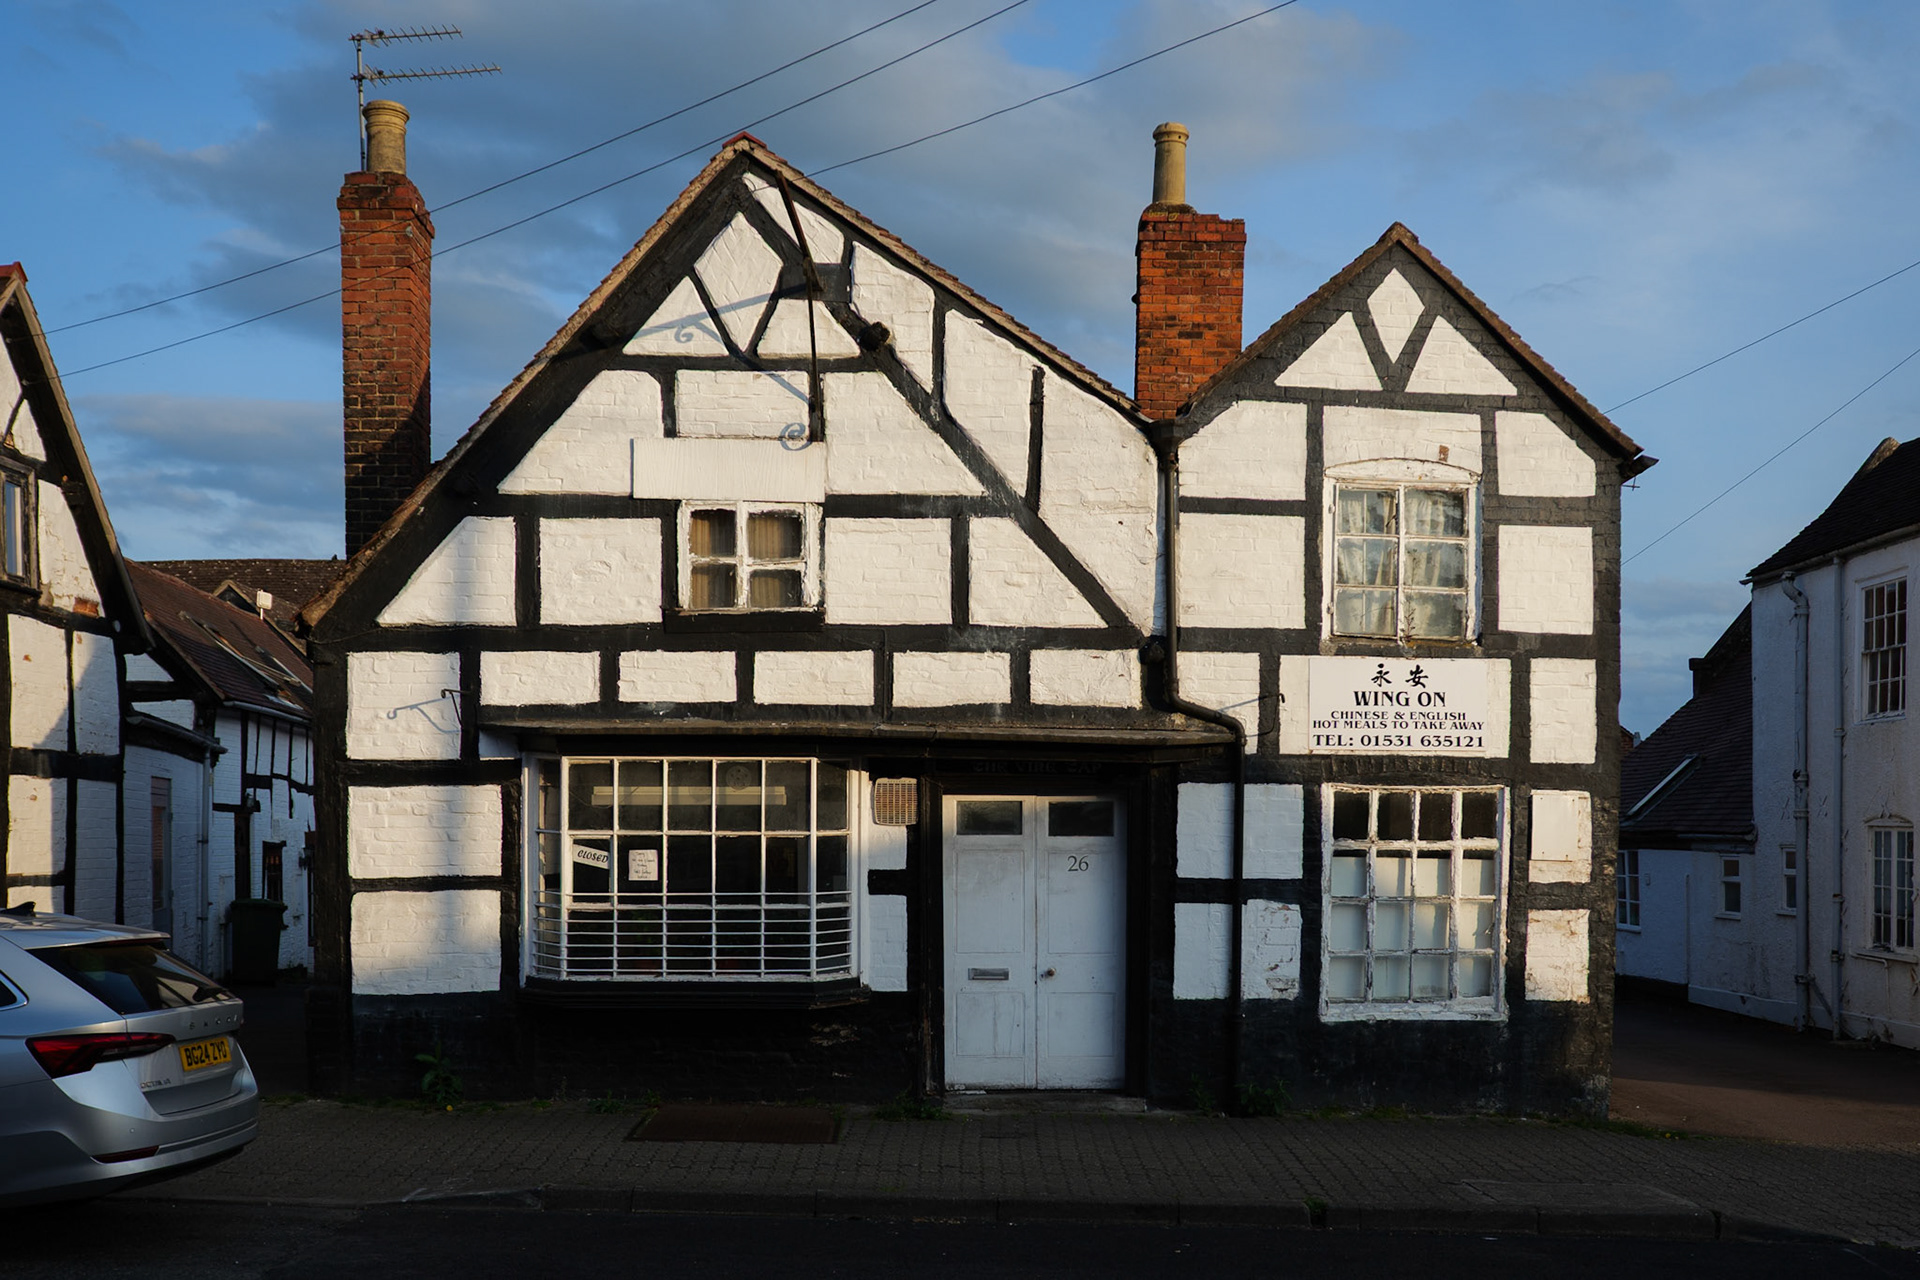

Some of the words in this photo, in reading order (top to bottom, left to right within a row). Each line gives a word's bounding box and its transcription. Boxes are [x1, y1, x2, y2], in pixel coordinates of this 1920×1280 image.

[1371, 663, 1429, 688] 永安
[1354, 691, 1410, 707] WING
[1417, 691, 1446, 707] ON
[1331, 711, 1389, 720] CHINESE
[1394, 711, 1405, 720] &
[1410, 712, 1467, 721] ENGLISH
[1313, 720, 1340, 729] HOT
[1344, 720, 1387, 729] MEALS
[1391, 720, 1409, 730] TO
[1413, 721, 1446, 730] TAKE
[1450, 721, 1484, 731] AWAY
[1313, 734, 1354, 747] TEL:
[1361, 735, 1413, 747] 01531
[1420, 735, 1484, 748] 635121
[577, 849, 609, 863] CLOSED
[1067, 855, 1089, 872] 26
[184, 1044, 210, 1067] BG24
